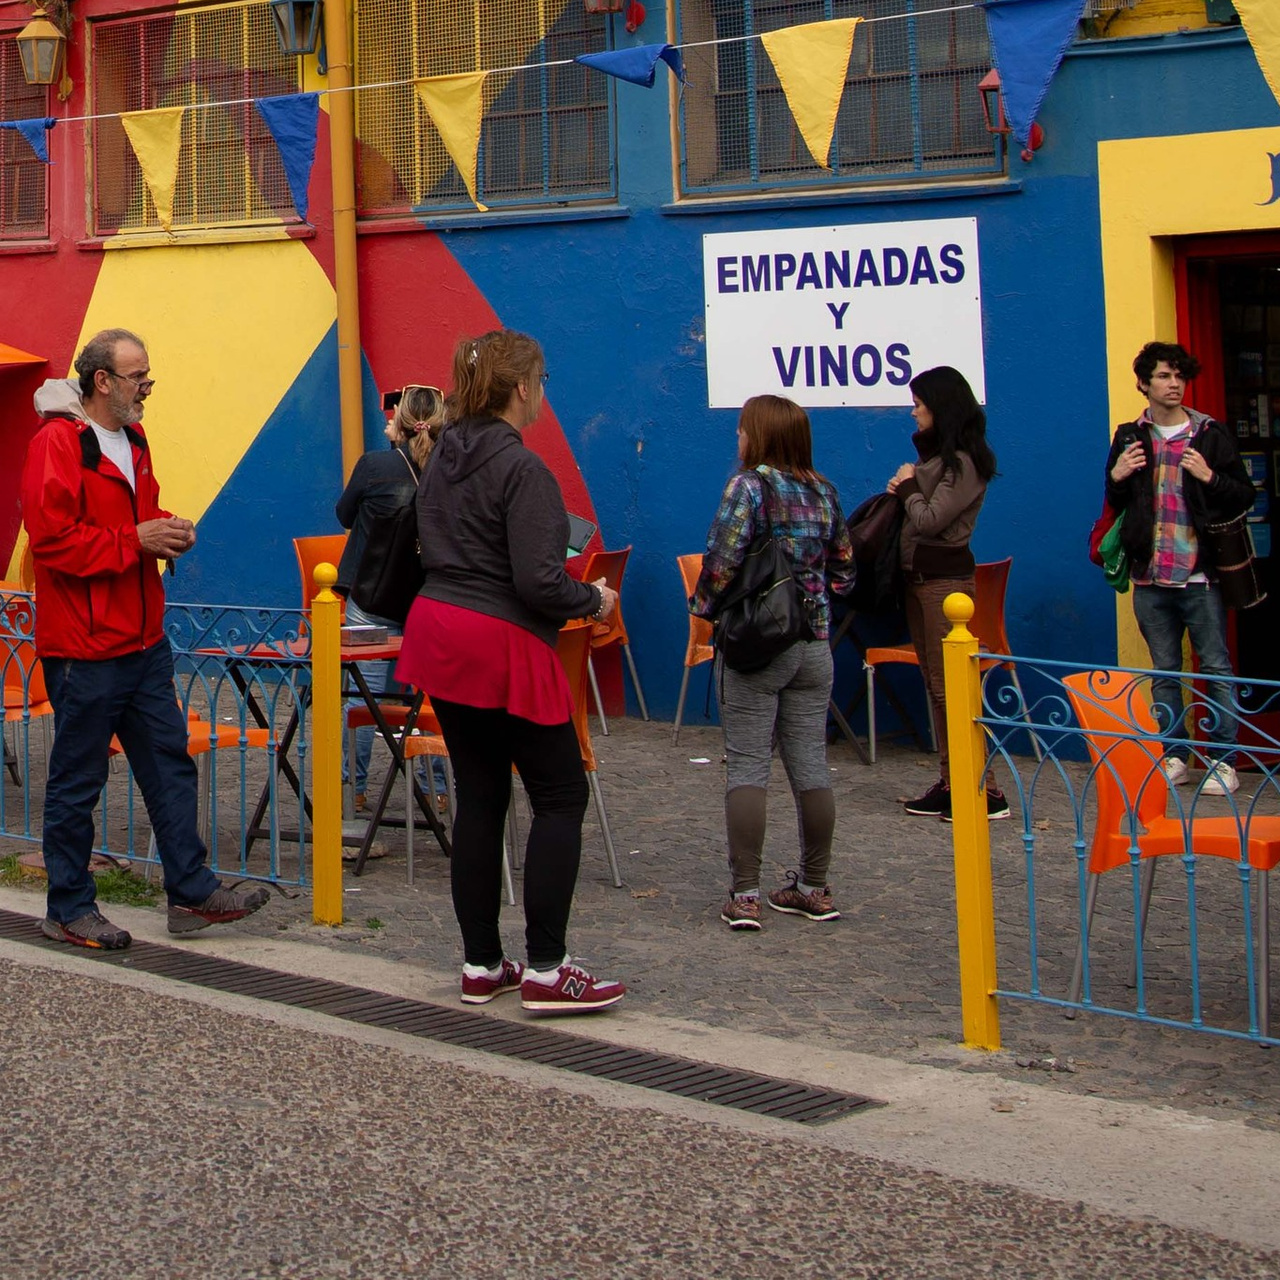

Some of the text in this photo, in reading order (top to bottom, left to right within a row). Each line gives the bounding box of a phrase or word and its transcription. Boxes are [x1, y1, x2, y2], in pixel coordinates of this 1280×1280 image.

[717, 243, 965, 293] EMPANADAS
[826, 302, 850, 329] Y
[772, 343, 912, 387] VINOS
[561, 976, 587, 999] N
